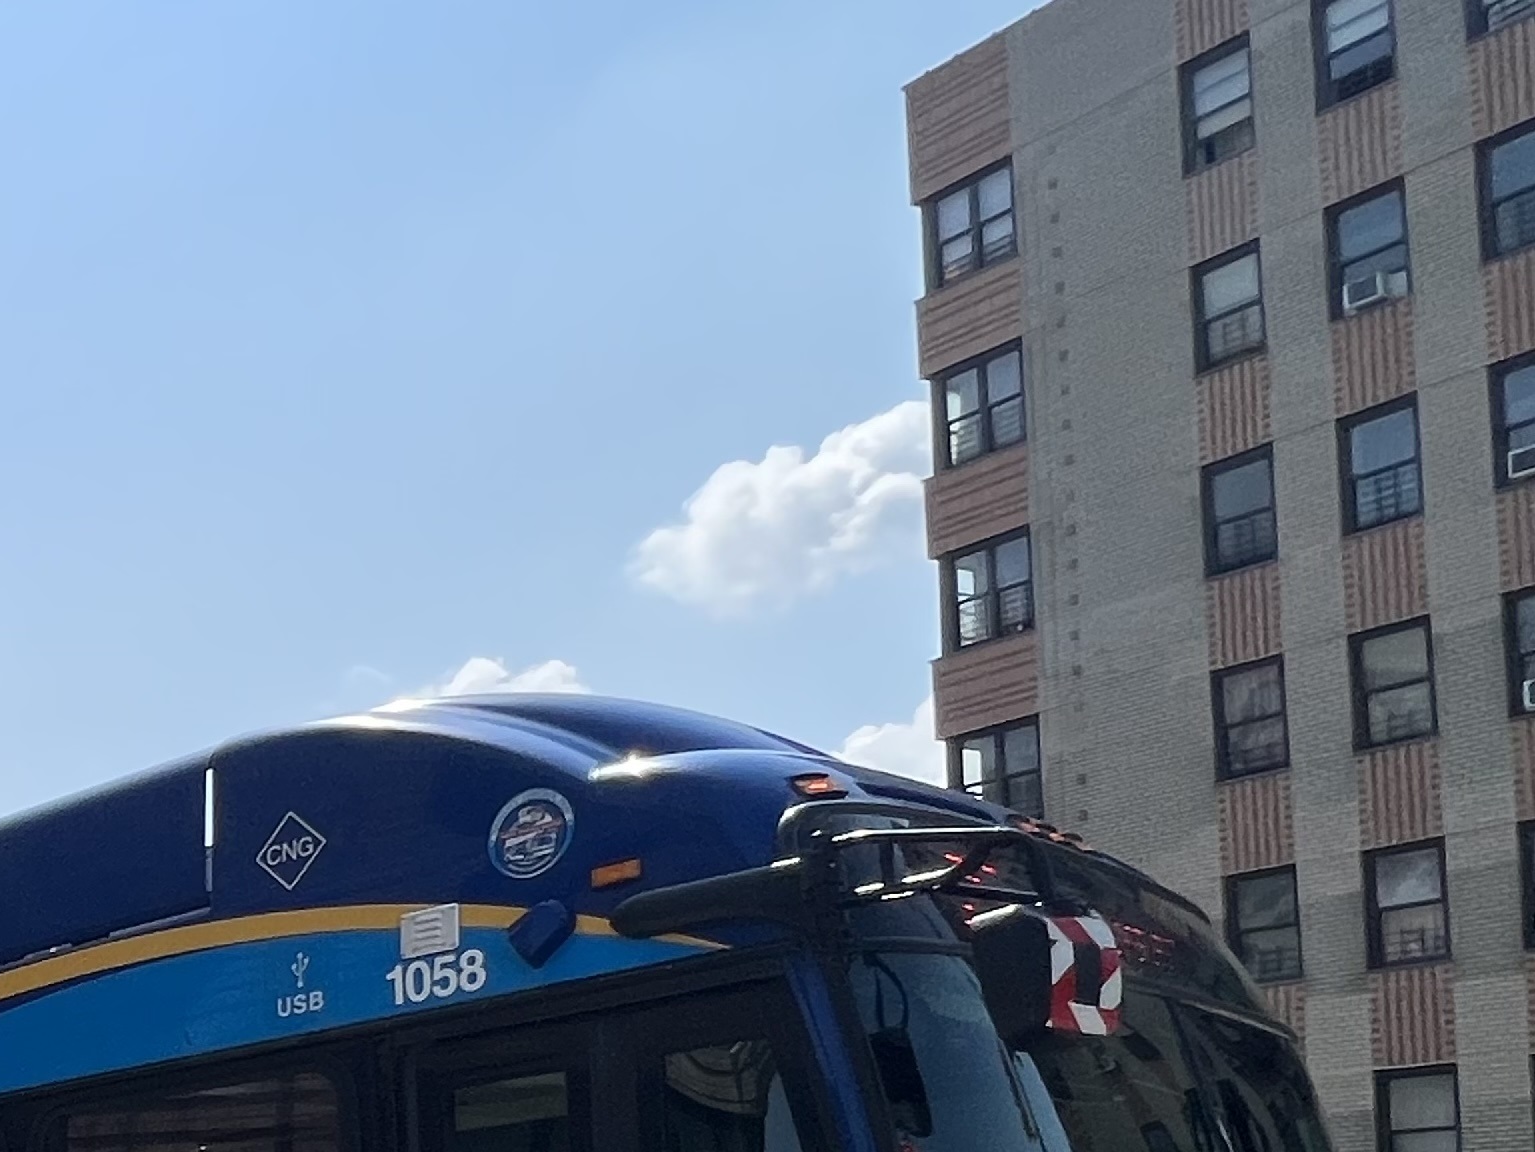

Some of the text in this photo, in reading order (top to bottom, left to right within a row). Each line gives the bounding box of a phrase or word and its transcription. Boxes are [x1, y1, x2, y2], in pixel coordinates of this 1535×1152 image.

[266, 836, 314, 866] CNG
[386, 949, 486, 1005] 1058
[277, 991, 324, 1017] USB
